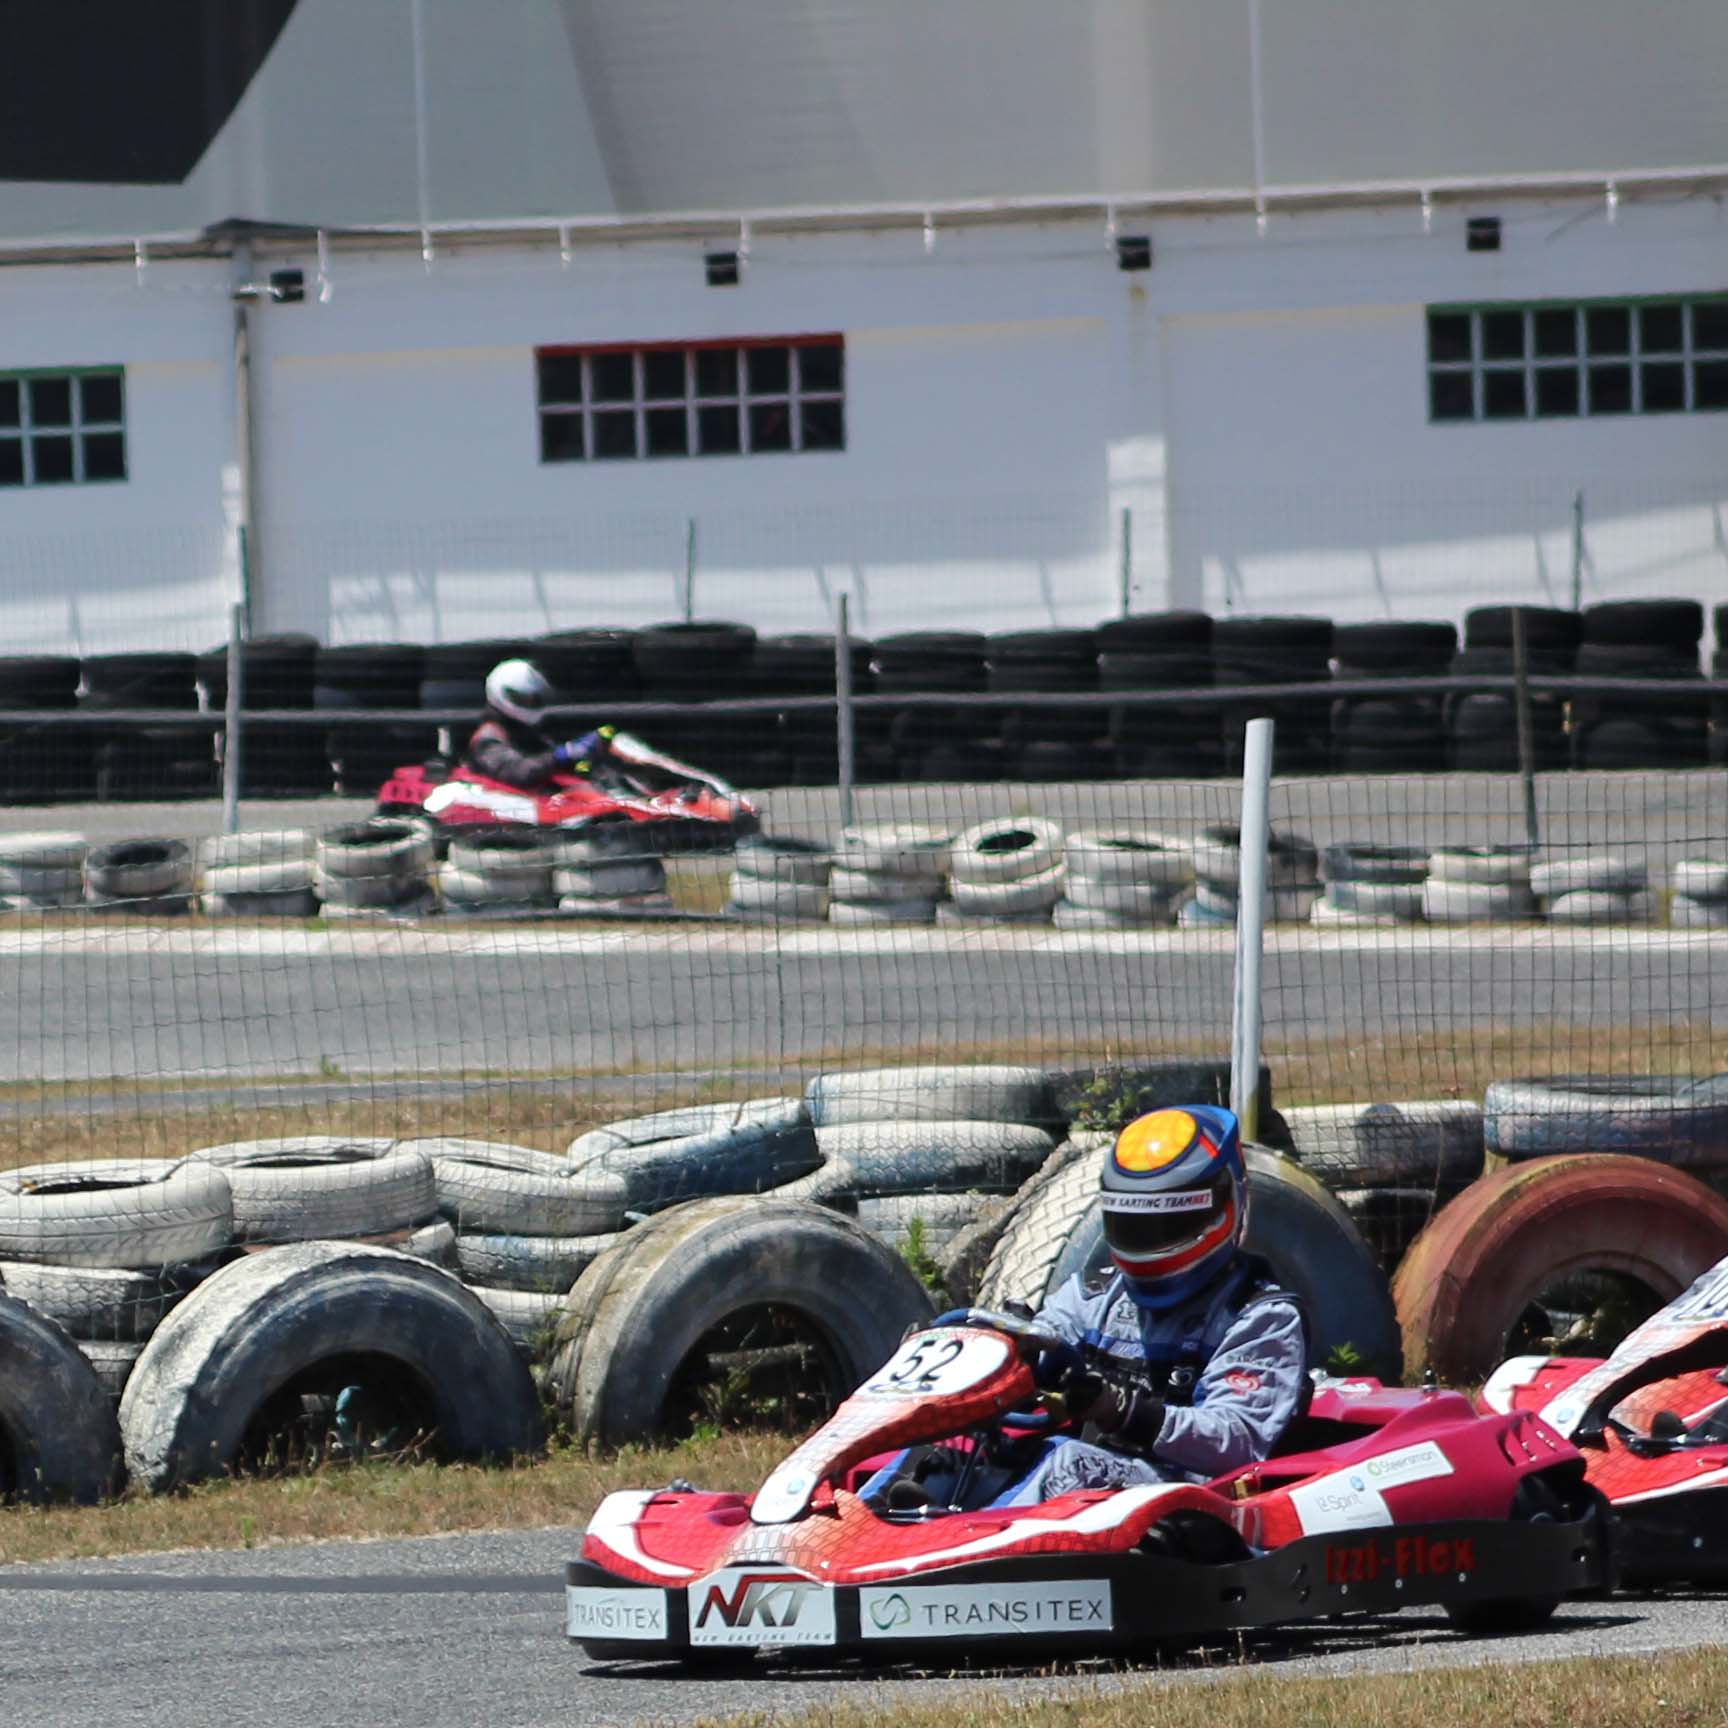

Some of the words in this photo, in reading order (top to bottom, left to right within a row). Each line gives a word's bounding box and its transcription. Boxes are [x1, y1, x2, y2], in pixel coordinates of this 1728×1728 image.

[890, 1338, 964, 1382] 52
[574, 1603, 661, 1629] TRANSITEX
[695, 1573, 826, 1629] NKT
[922, 1599, 1103, 1625] TRANSITEX
